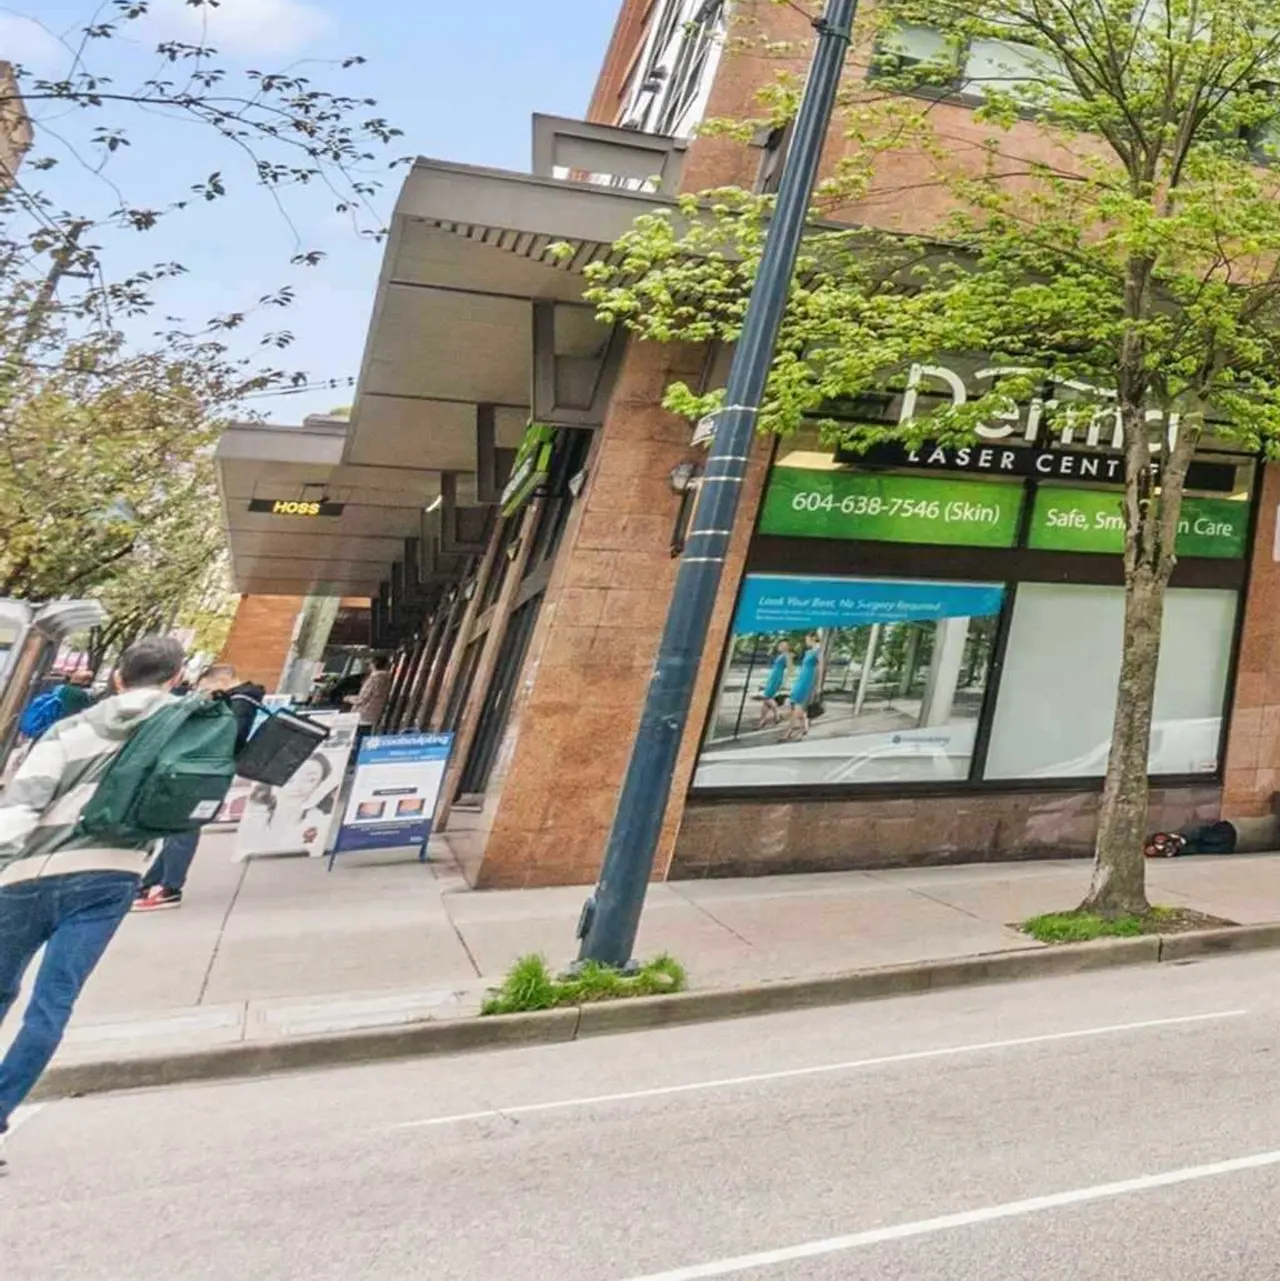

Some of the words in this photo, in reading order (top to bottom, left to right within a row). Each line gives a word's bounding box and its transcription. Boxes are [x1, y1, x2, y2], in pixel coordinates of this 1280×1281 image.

[907, 447, 1016, 470] LASER
[272, 500, 320, 515] HOSS
[791, 491, 940, 519] 604-638-7546
[944, 502, 1001, 525] (Skin)
[1045, 508, 1090, 531] Safe,
[1193, 518, 1234, 537] Care
